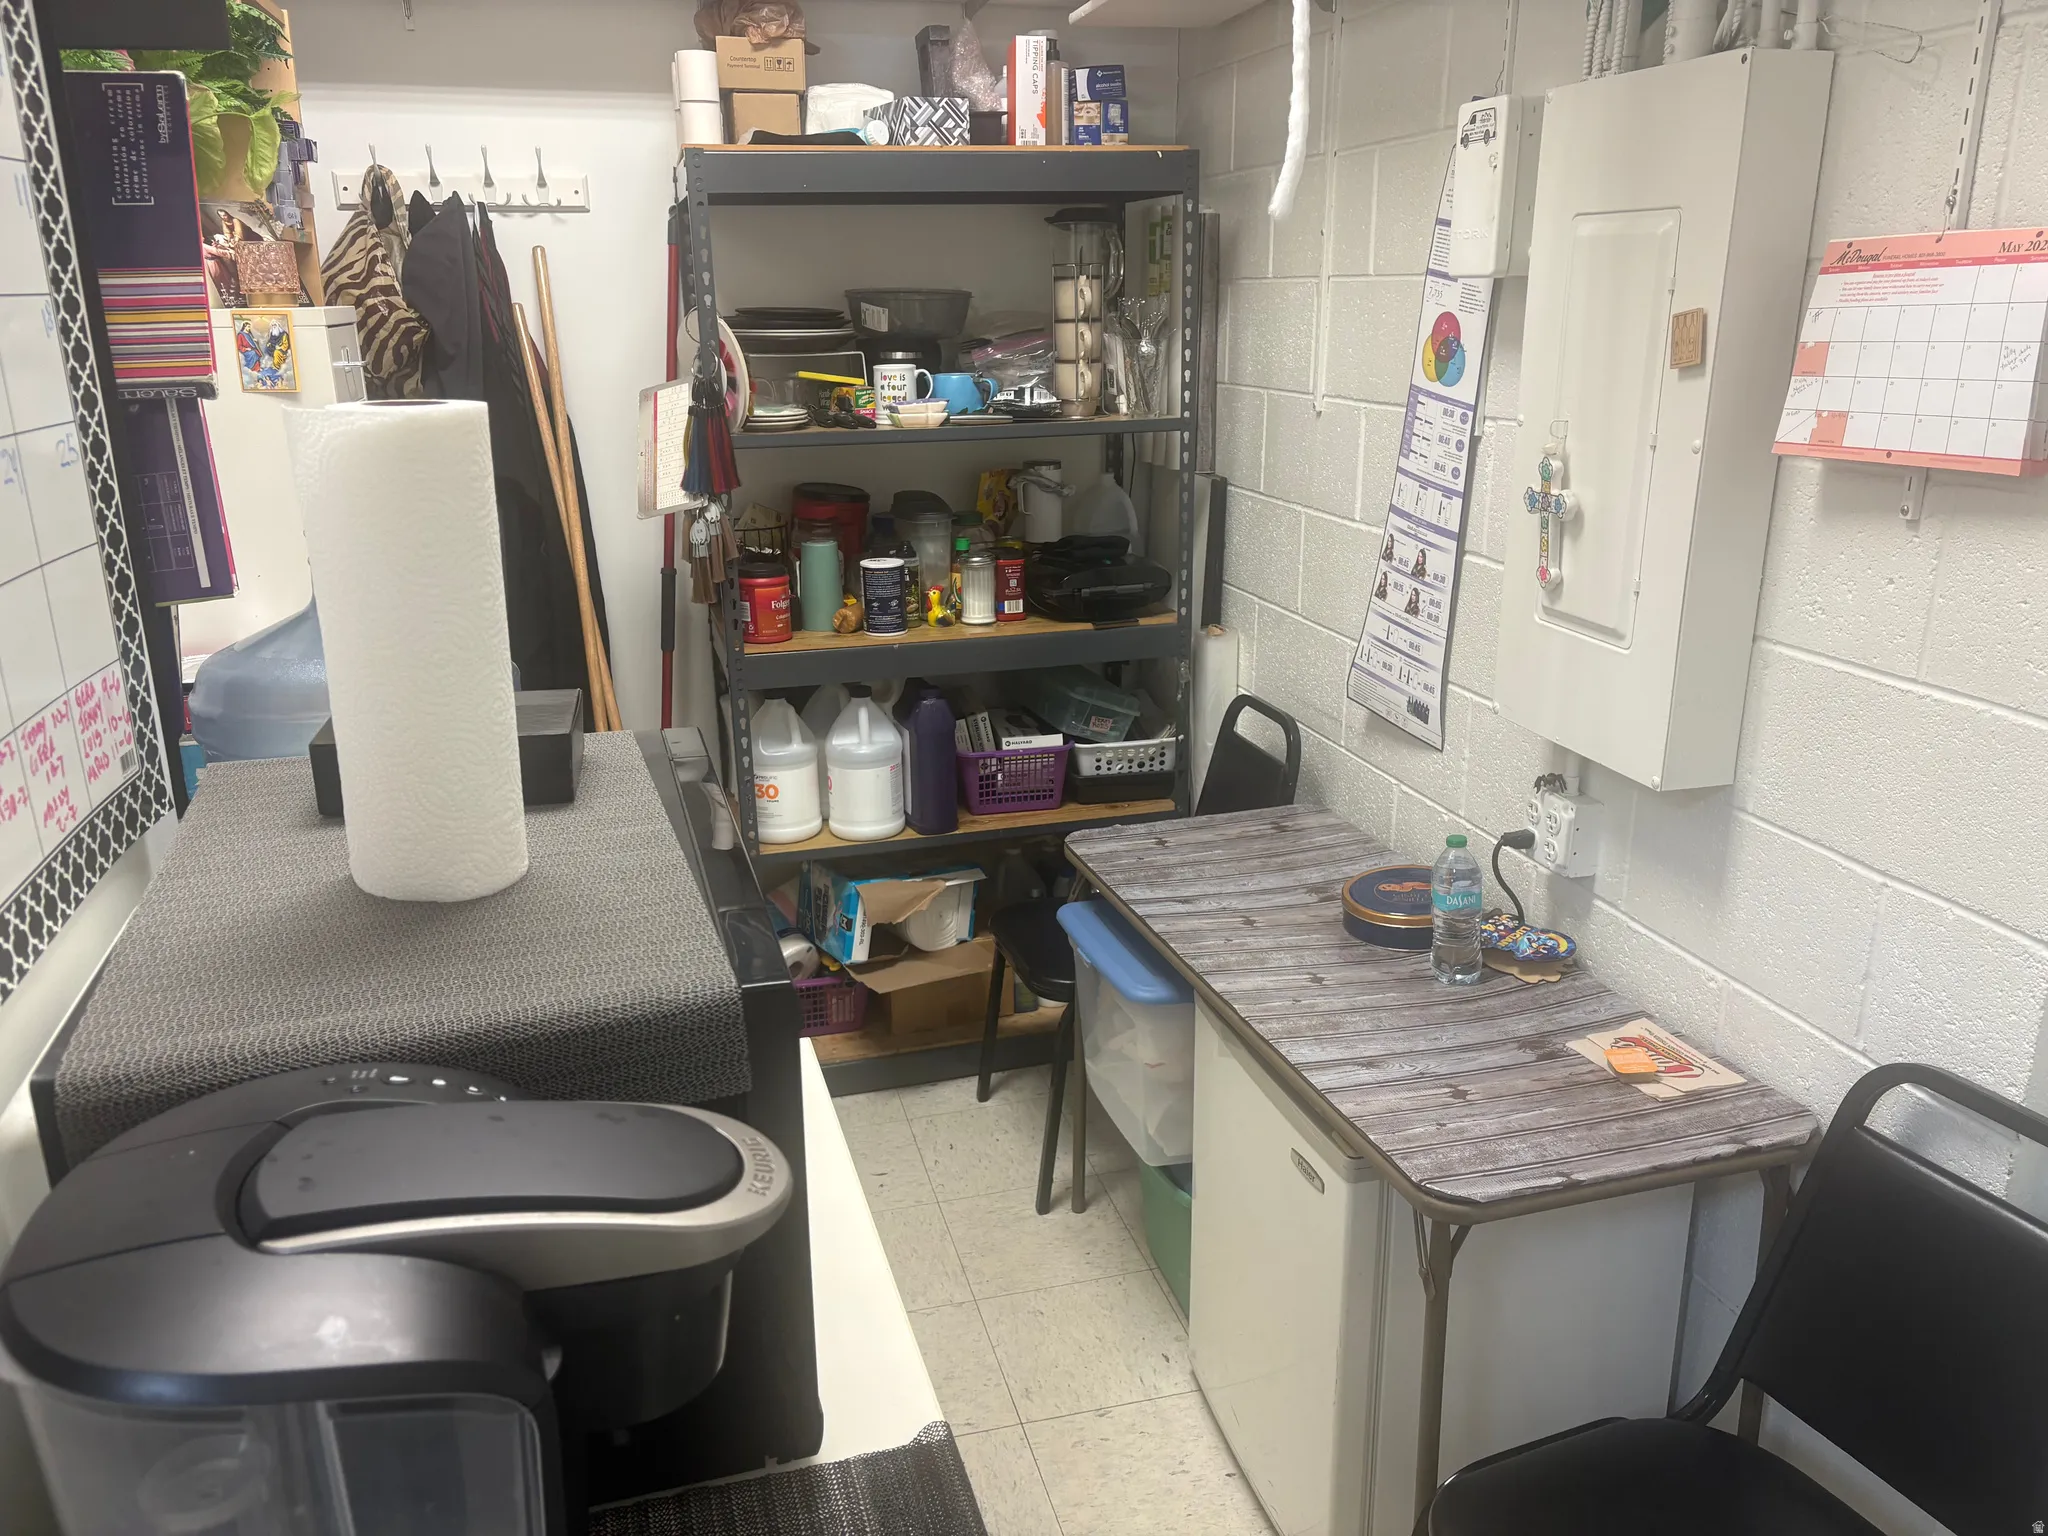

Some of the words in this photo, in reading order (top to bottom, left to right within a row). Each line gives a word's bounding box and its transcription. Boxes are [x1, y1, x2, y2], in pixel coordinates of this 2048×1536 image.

[729, 55, 757, 63] Countertop
[1031, 39, 1039, 71] TIPPING
[1031, 72, 1039, 95] CAPS
[1830, 246, 1888, 266] McDougal
[880, 372, 897, 381] love
[899, 373, 906, 381] is
[887, 382, 907, 391] four
[880, 391, 907, 403] legged
[55, 432, 80, 468] 25
[754, 783, 779, 800] 30
[1446, 894, 1477, 908] DASANI
[743, 1136, 776, 1198] KEURIG
[1297, 1158, 1316, 1183] Haier
